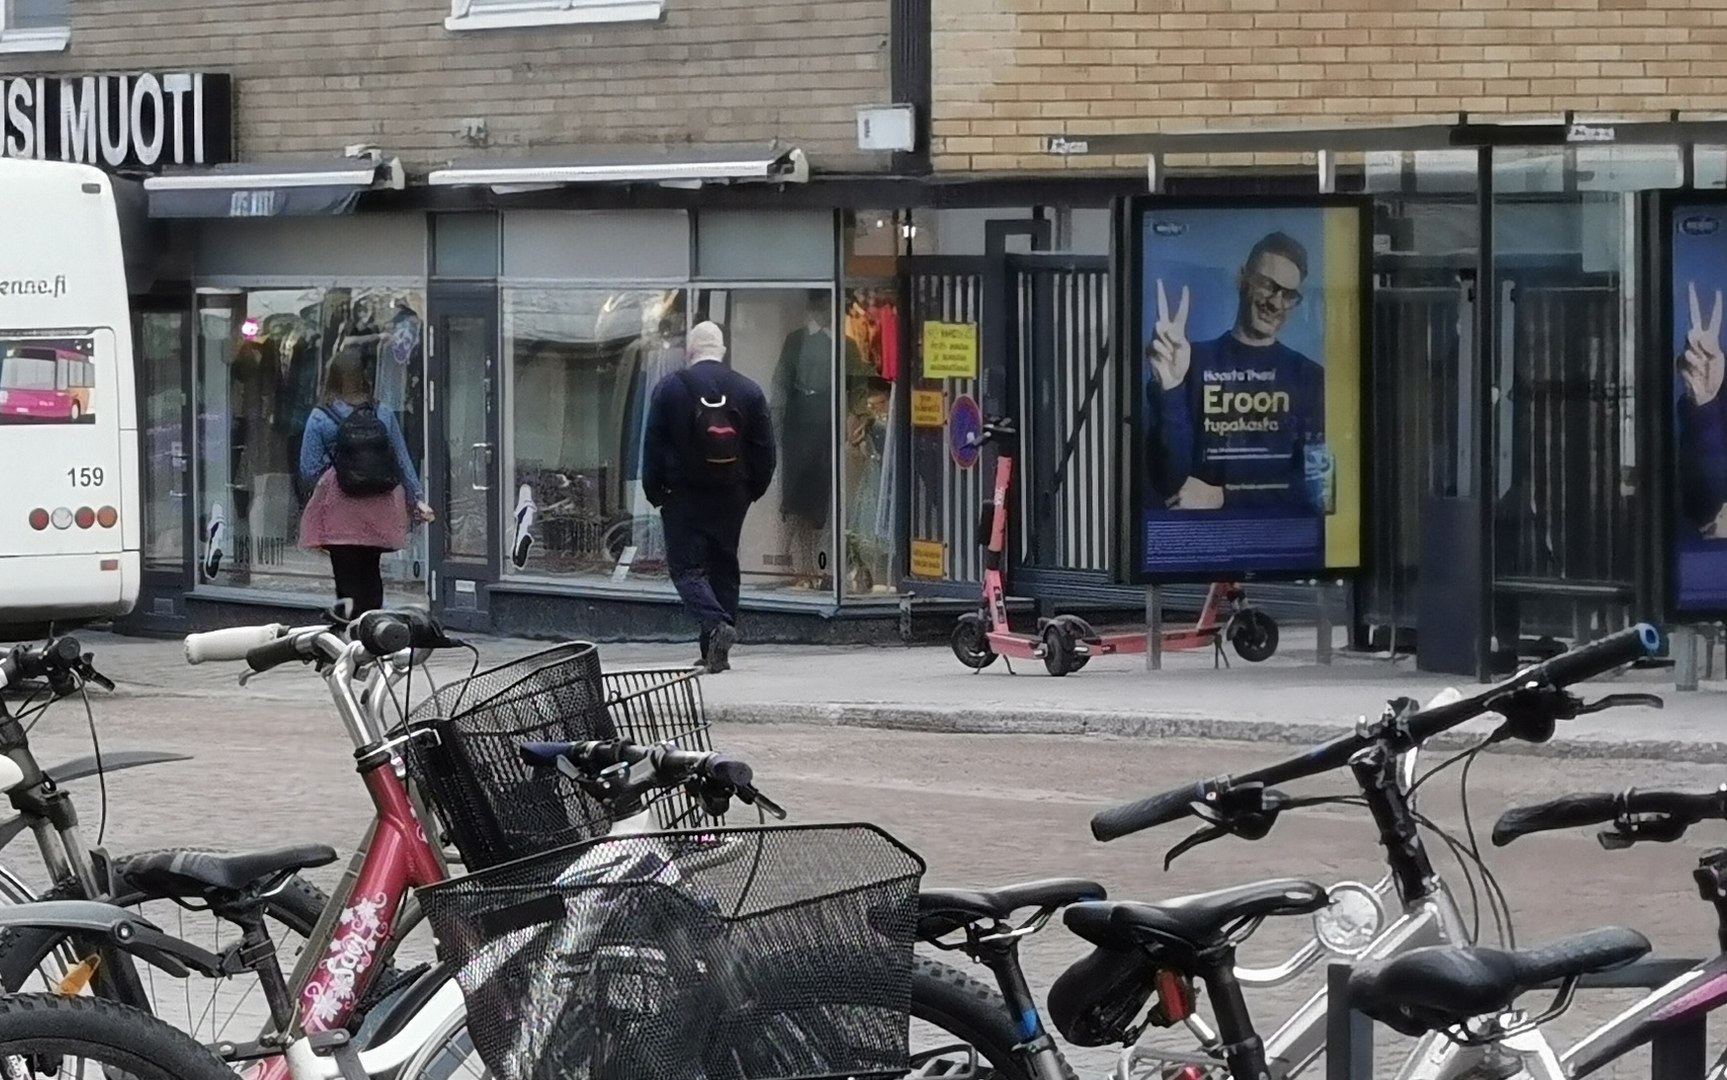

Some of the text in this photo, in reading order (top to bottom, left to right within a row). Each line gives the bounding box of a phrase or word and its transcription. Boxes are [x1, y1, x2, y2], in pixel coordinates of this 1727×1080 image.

[60, 73, 203, 166] MUOTI
[1204, 385, 1290, 414] Eroon
[1204, 418, 1279, 435] tupakasta
[68, 467, 104, 488] 159
